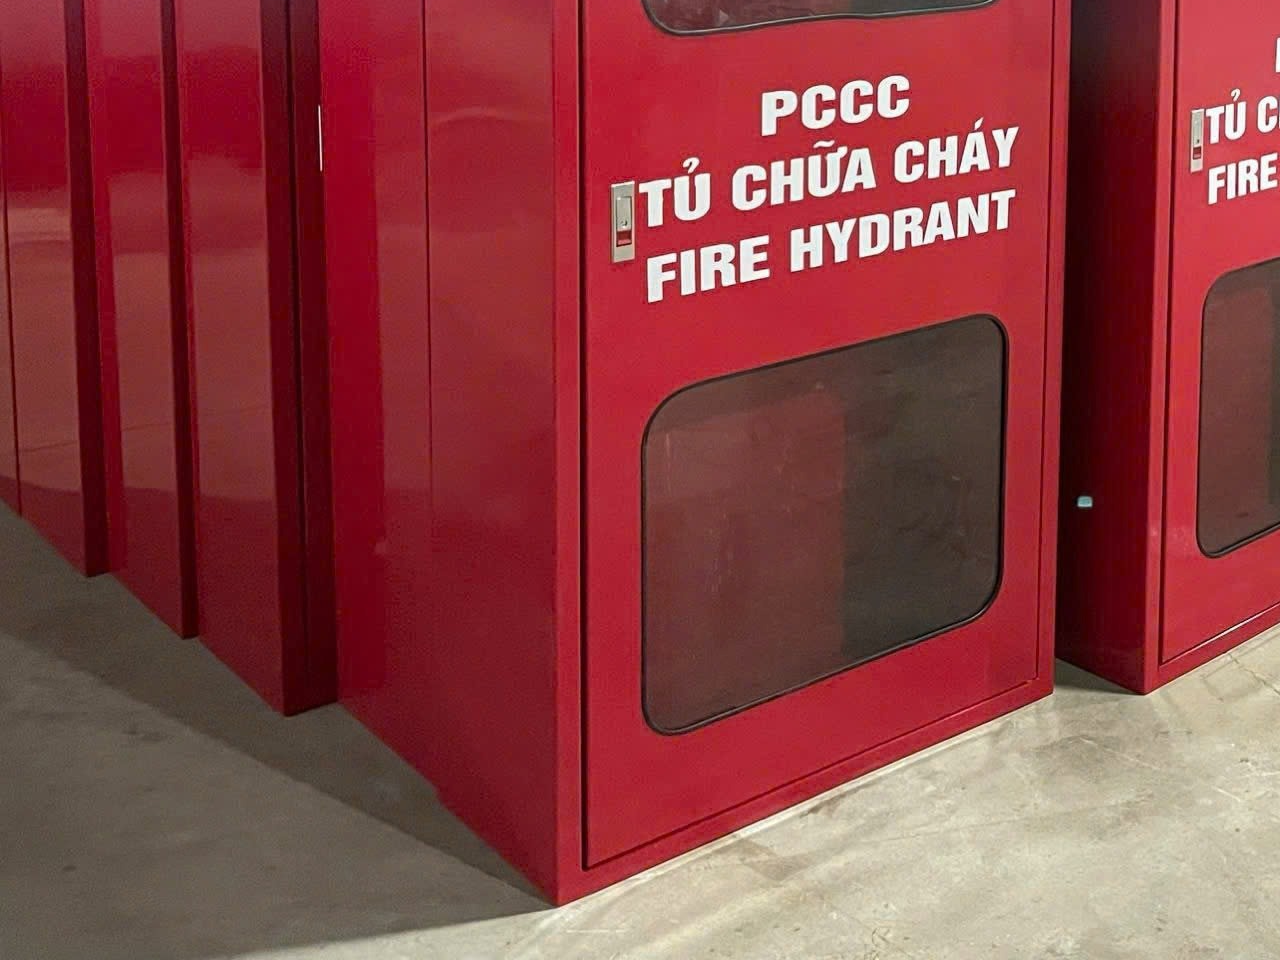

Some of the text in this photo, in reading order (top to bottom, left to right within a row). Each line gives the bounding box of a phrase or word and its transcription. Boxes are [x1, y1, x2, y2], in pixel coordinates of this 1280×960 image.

[761, 75, 910, 137] PCCC
[1205, 88, 1247, 145] TỦ
[638, 116, 1020, 228] TỦ CHỮA CHÁY
[1207, 152, 1279, 205] FIRE
[646, 188, 1017, 303] FIRE HYDRANT
